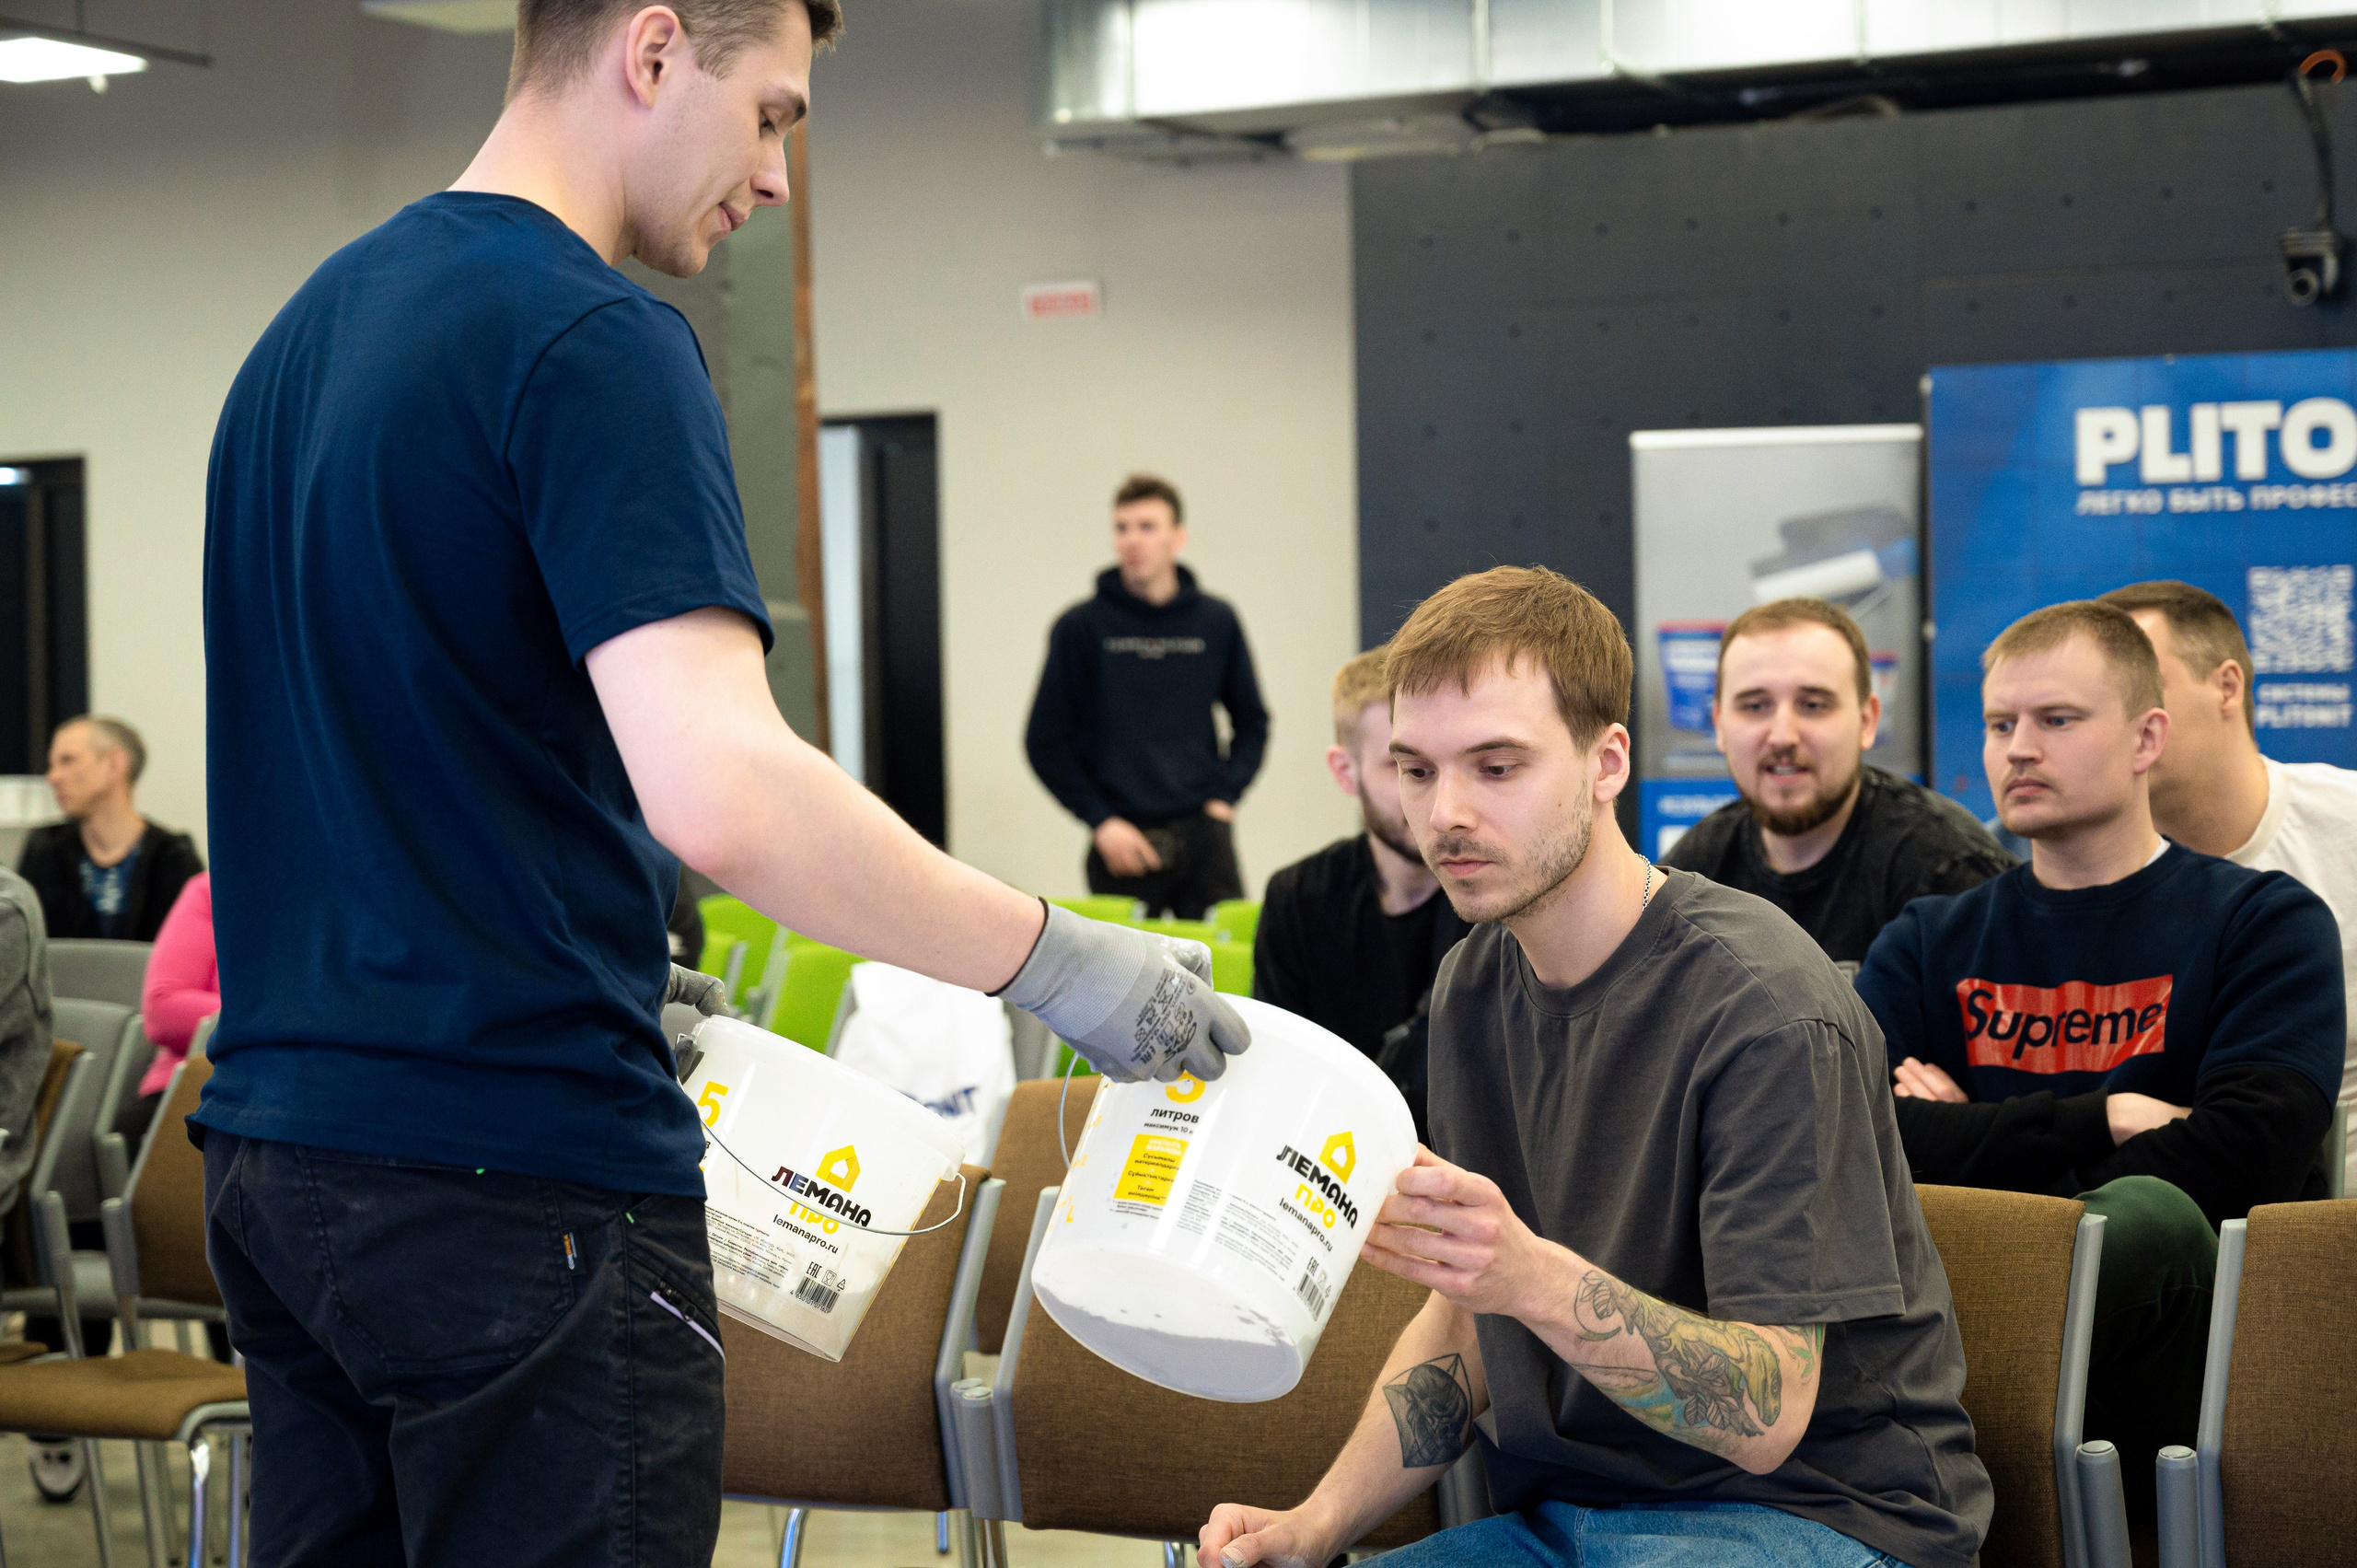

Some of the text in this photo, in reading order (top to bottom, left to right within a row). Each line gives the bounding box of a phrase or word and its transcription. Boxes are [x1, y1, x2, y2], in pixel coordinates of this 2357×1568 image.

[2074, 397, 2357, 486] PLITO
[2075, 489, 2165, 517] ЛЕГКО
[2168, 486, 2246, 514] БЫТЬ
[1967, 989, 2163, 1060] Supreme
[697, 1080, 729, 1130] 5
[1144, 1121, 1179, 1132] максимум
[1180, 1125, 1189, 1133] 10
[1150, 1108, 1200, 1124] литров
[771, 1166, 872, 1228] ЛЕМАНА
[1276, 1144, 1359, 1230] ЛЕМАНА
[1295, 1182, 1336, 1229] ПРО
[772, 1214, 839, 1254] lemanapro.ru
[789, 1202, 840, 1235] ПРО
[1279, 1197, 1333, 1252] lemanapro.ru
